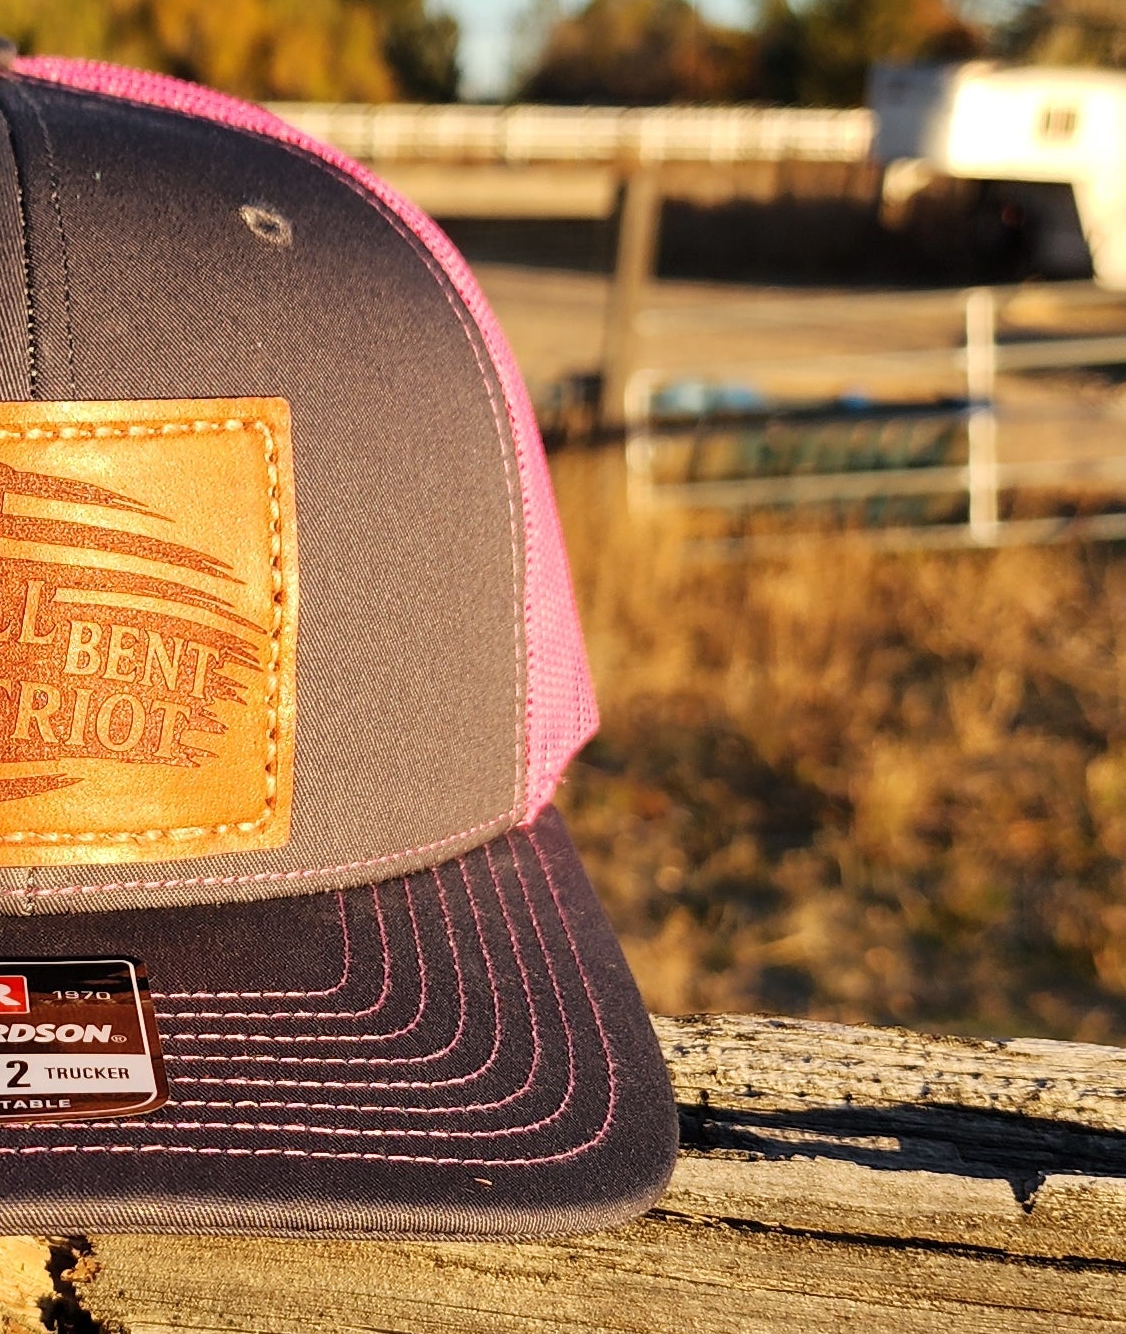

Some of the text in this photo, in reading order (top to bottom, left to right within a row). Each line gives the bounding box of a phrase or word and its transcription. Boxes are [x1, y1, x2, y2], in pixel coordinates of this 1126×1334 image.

[64, 619, 224, 701] BENT
[51, 989, 112, 1001] 1970
[44, 1066, 130, 1081] TRUCKER
